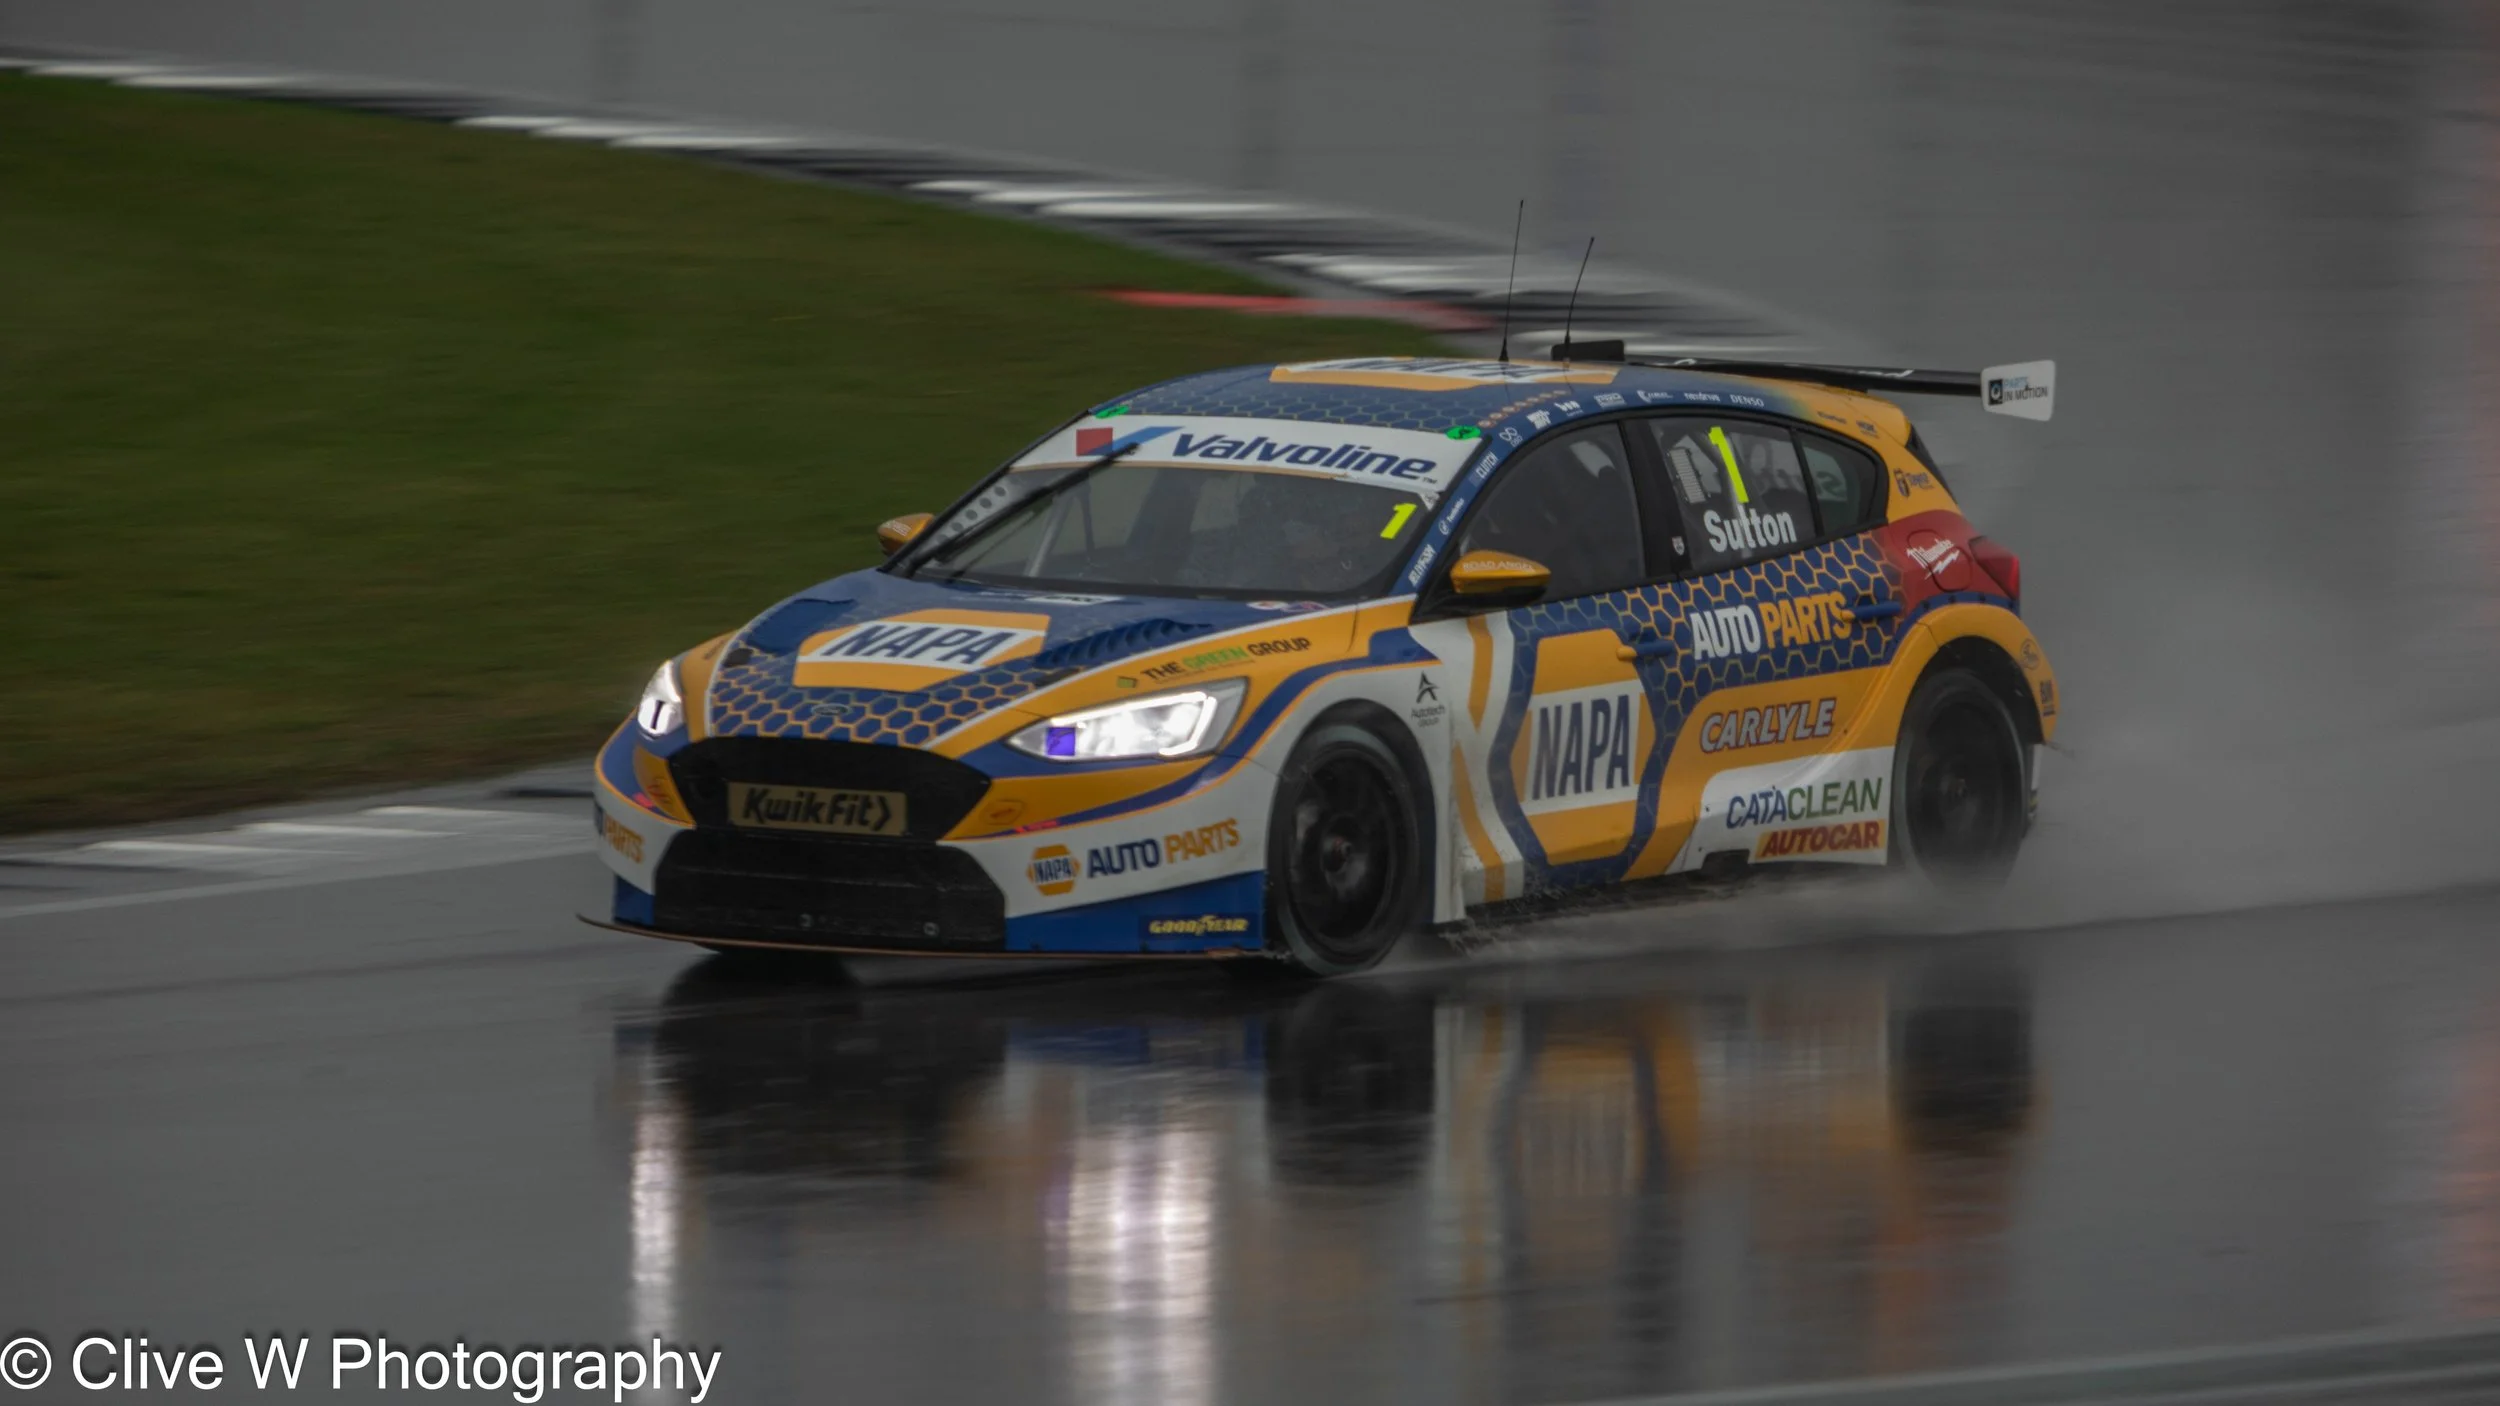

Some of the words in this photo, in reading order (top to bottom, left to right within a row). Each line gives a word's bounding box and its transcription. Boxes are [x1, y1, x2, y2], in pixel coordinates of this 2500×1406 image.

[1729, 394, 1765, 408] DENSO
[1172, 433, 1436, 480] Valvoline
[1708, 426, 1749, 503] 1
[1380, 502, 1417, 539] 1
[1703, 503, 1797, 553] Sutton
[821, 621, 1018, 666] NAPA
[1690, 604, 1761, 660] AUTO
[1759, 592, 1851, 649] PARTS
[1141, 661, 1184, 681] THE
[1183, 645, 1249, 670] GREEN
[1247, 636, 1311, 657] GROUP
[1532, 694, 1630, 801] NAPA
[1700, 698, 1836, 754] CARLYLE
[1726, 777, 1882, 829] CATACLEAN
[1033, 857, 1072, 884] NAPA
[1087, 838, 1160, 878] AUTO
[1164, 817, 1241, 864] PARTS
[1760, 822, 1881, 858] AUTOCAR
[1149, 914, 1249, 936] GOODYEAR
